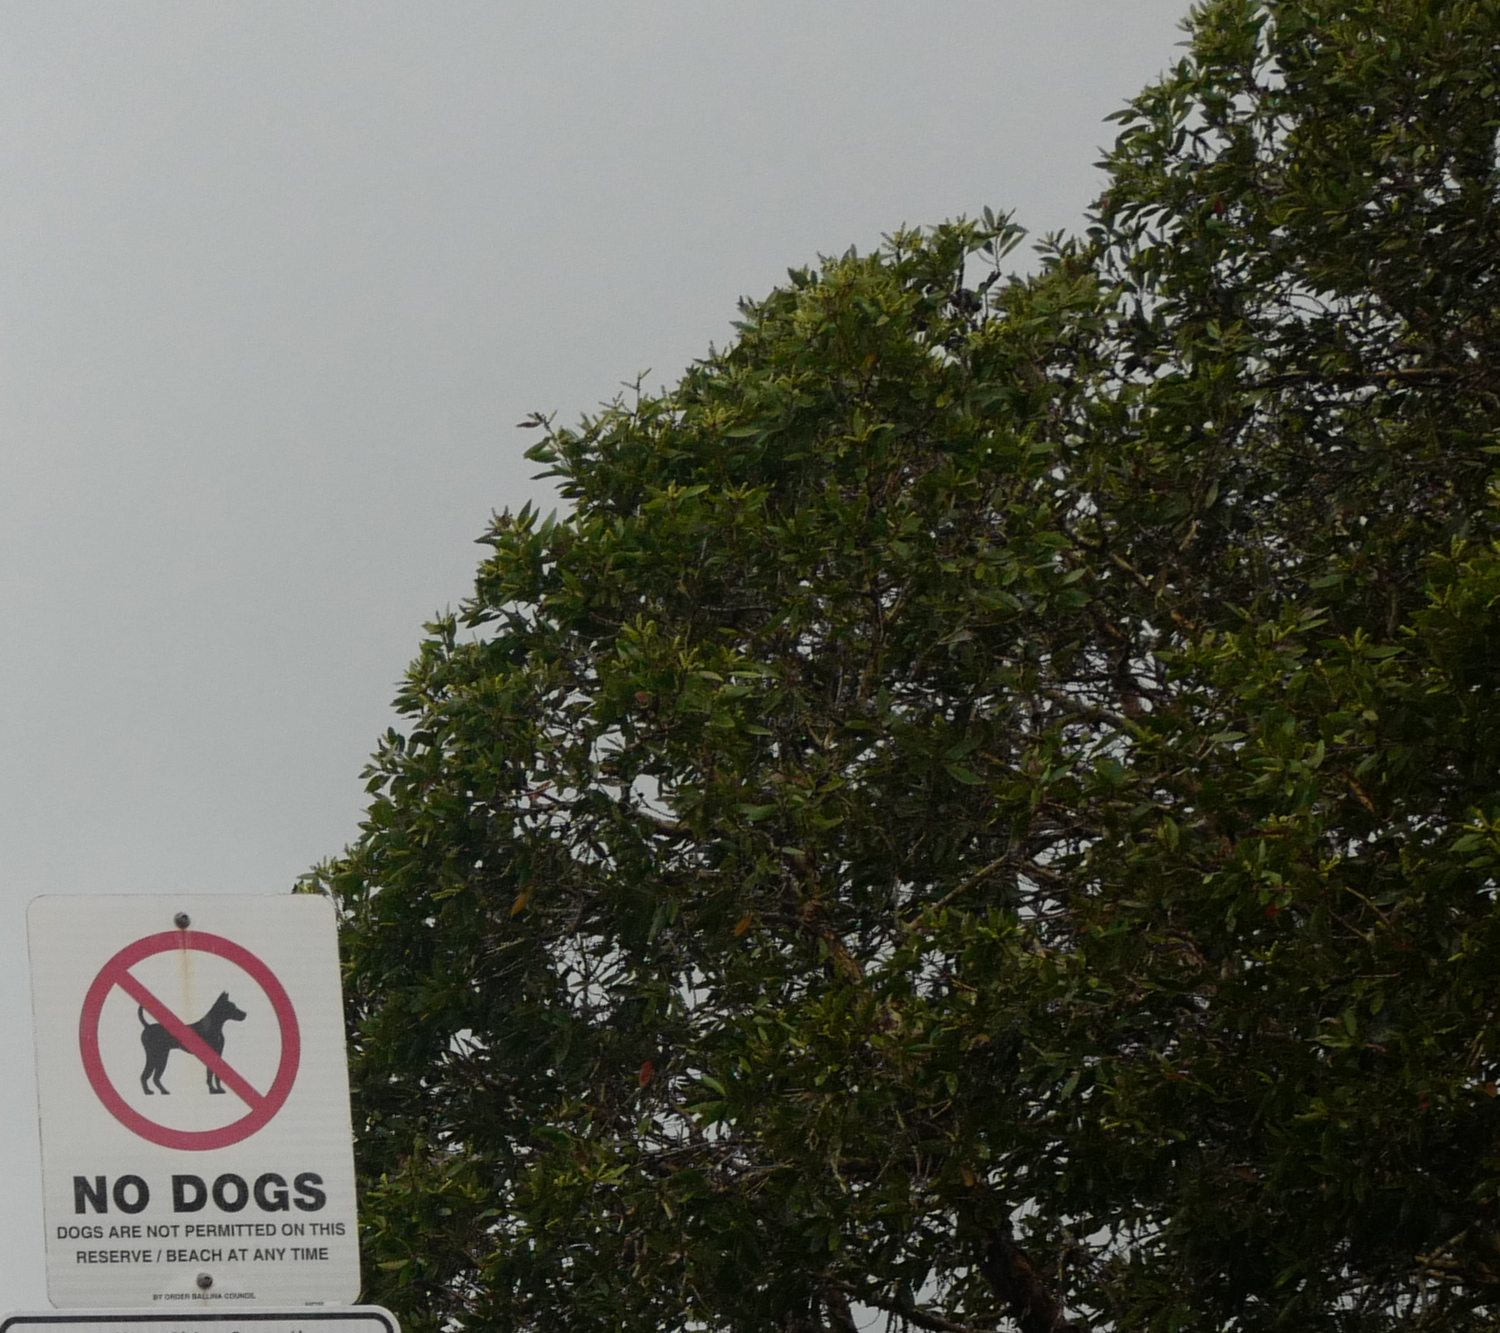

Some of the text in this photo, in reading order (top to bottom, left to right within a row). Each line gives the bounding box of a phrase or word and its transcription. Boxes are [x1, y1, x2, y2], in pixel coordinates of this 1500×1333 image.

[72, 1172, 327, 1214] NO DOGS
[57, 1223, 345, 1239] DOGS ARE NOT PERMITTED ON THIS
[76, 1251, 152, 1263] RESERVE
[166, 1249, 222, 1262] BEACH
[228, 1249, 248, 1261] AT
[253, 1249, 286, 1261] ANY
[291, 1248, 328, 1260] TIME
[224, 1292, 256, 1300] COUNCIL
